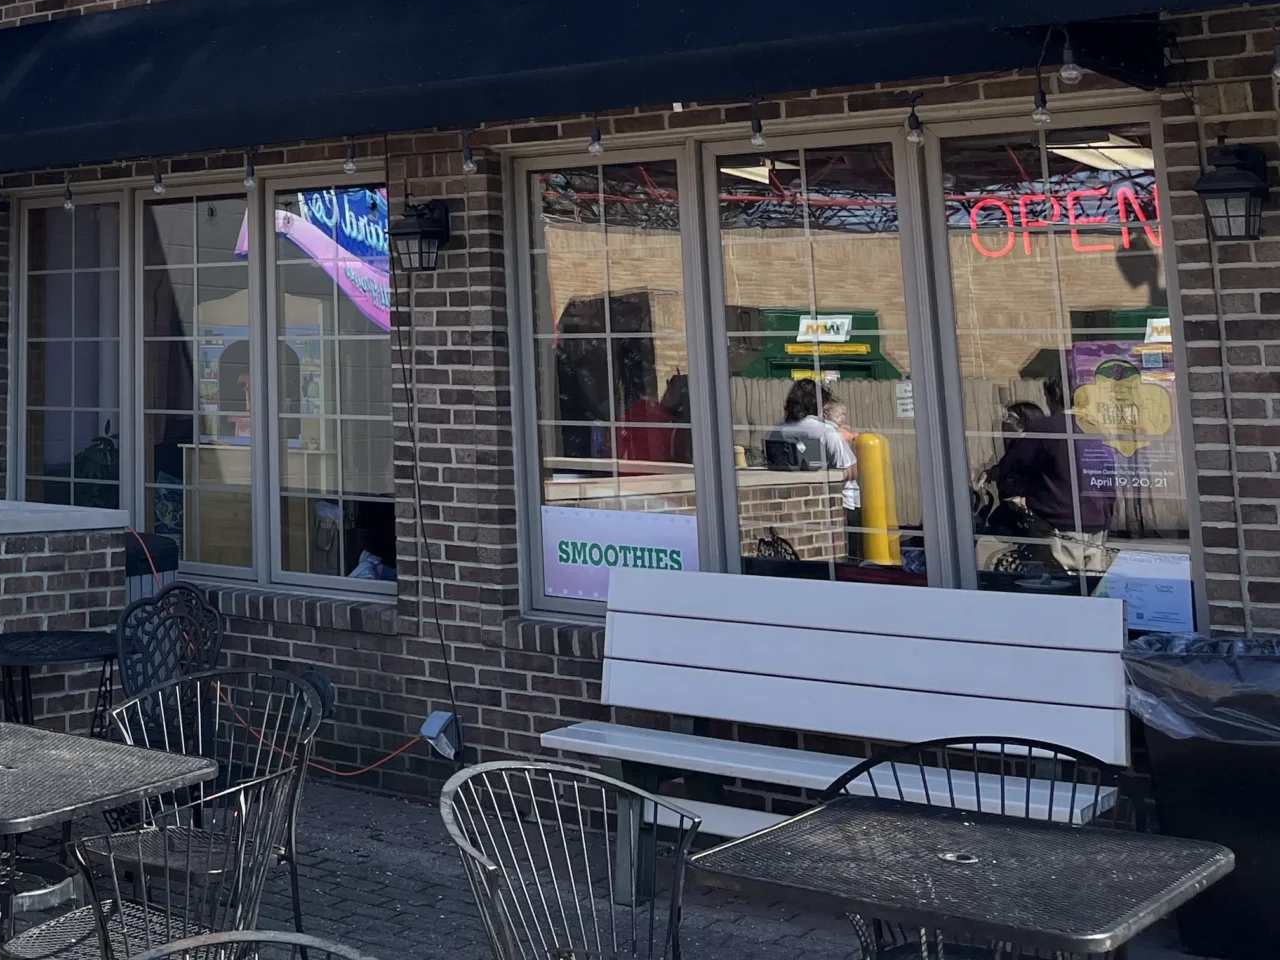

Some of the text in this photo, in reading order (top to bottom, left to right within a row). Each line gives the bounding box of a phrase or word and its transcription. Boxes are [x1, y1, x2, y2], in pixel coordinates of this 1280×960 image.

[969, 183, 1163, 258] OPEN
[1097, 402, 1142, 414] BEAUTY
[1102, 413, 1137, 425] BEAST
[1090, 476, 1167, 488] April 19, 20, 21
[558, 540, 683, 571] SMOOTHIES
